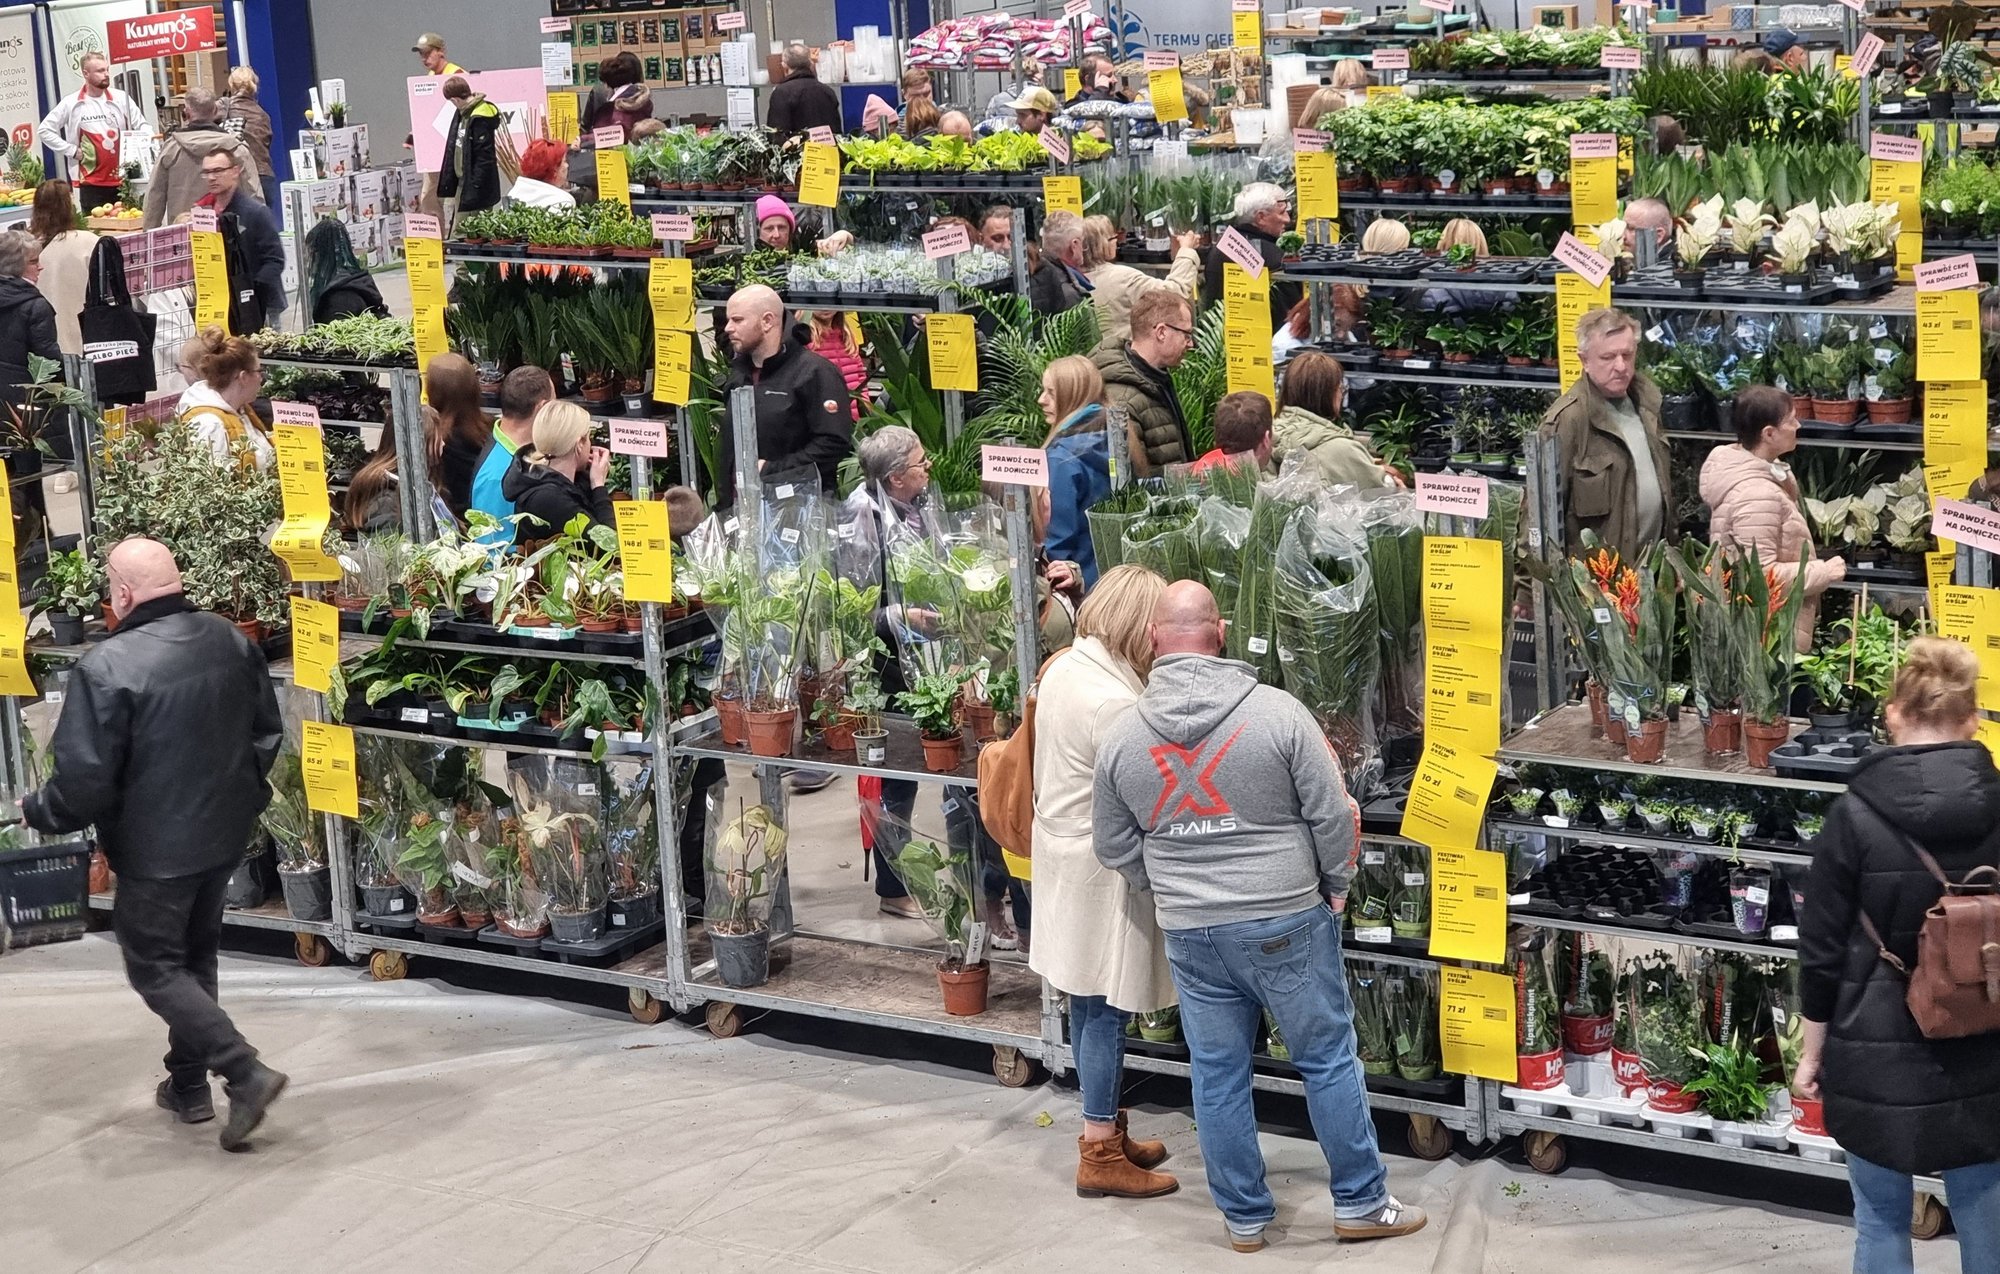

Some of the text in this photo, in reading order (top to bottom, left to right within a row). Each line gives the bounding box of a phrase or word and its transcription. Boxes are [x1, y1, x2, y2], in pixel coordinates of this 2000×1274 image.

[125, 13, 197, 50] Kuvings
[1153, 34, 1200, 46] TERMY
[0, 36, 23, 59] ings
[0, 67, 26, 77] rotowa
[15, 130, 30, 142] 10
[1920, 266, 1952, 277] SPRAWDŹ
[1936, 272, 1968, 283] DONICZCE
[93, 351, 113, 360] ALBO
[614, 427, 643, 436] SPRAWDŹ
[629, 438, 657, 447] DONICZCE
[988, 455, 1041, 465] SPRAWDŹ CENĘ
[1004, 466, 1039, 475] DONICZCE
[1421, 482, 1481, 495] SPRAWDŹ CENĘ
[1438, 496, 1477, 505] DONICZCE
[1942, 508, 1986, 525] SPRAWDŹ
[1945, 521, 2000, 542] NA DONICZC
[1430, 581, 1443, 589] 47
[1432, 688, 1444, 696] 44
[1421, 773, 1432, 783] 10
[1169, 817, 1237, 836] RAILS
[1438, 883, 1447, 892] 17
[1446, 1004, 1457, 1013] 71
[1526, 988, 1535, 1046] Lipstickplant
[1721, 1002, 1732, 1046] stickplant
[1545, 1057, 1562, 1078] HP
[1617, 1060, 1641, 1078] HP
[1380, 1208, 1398, 1225] N
